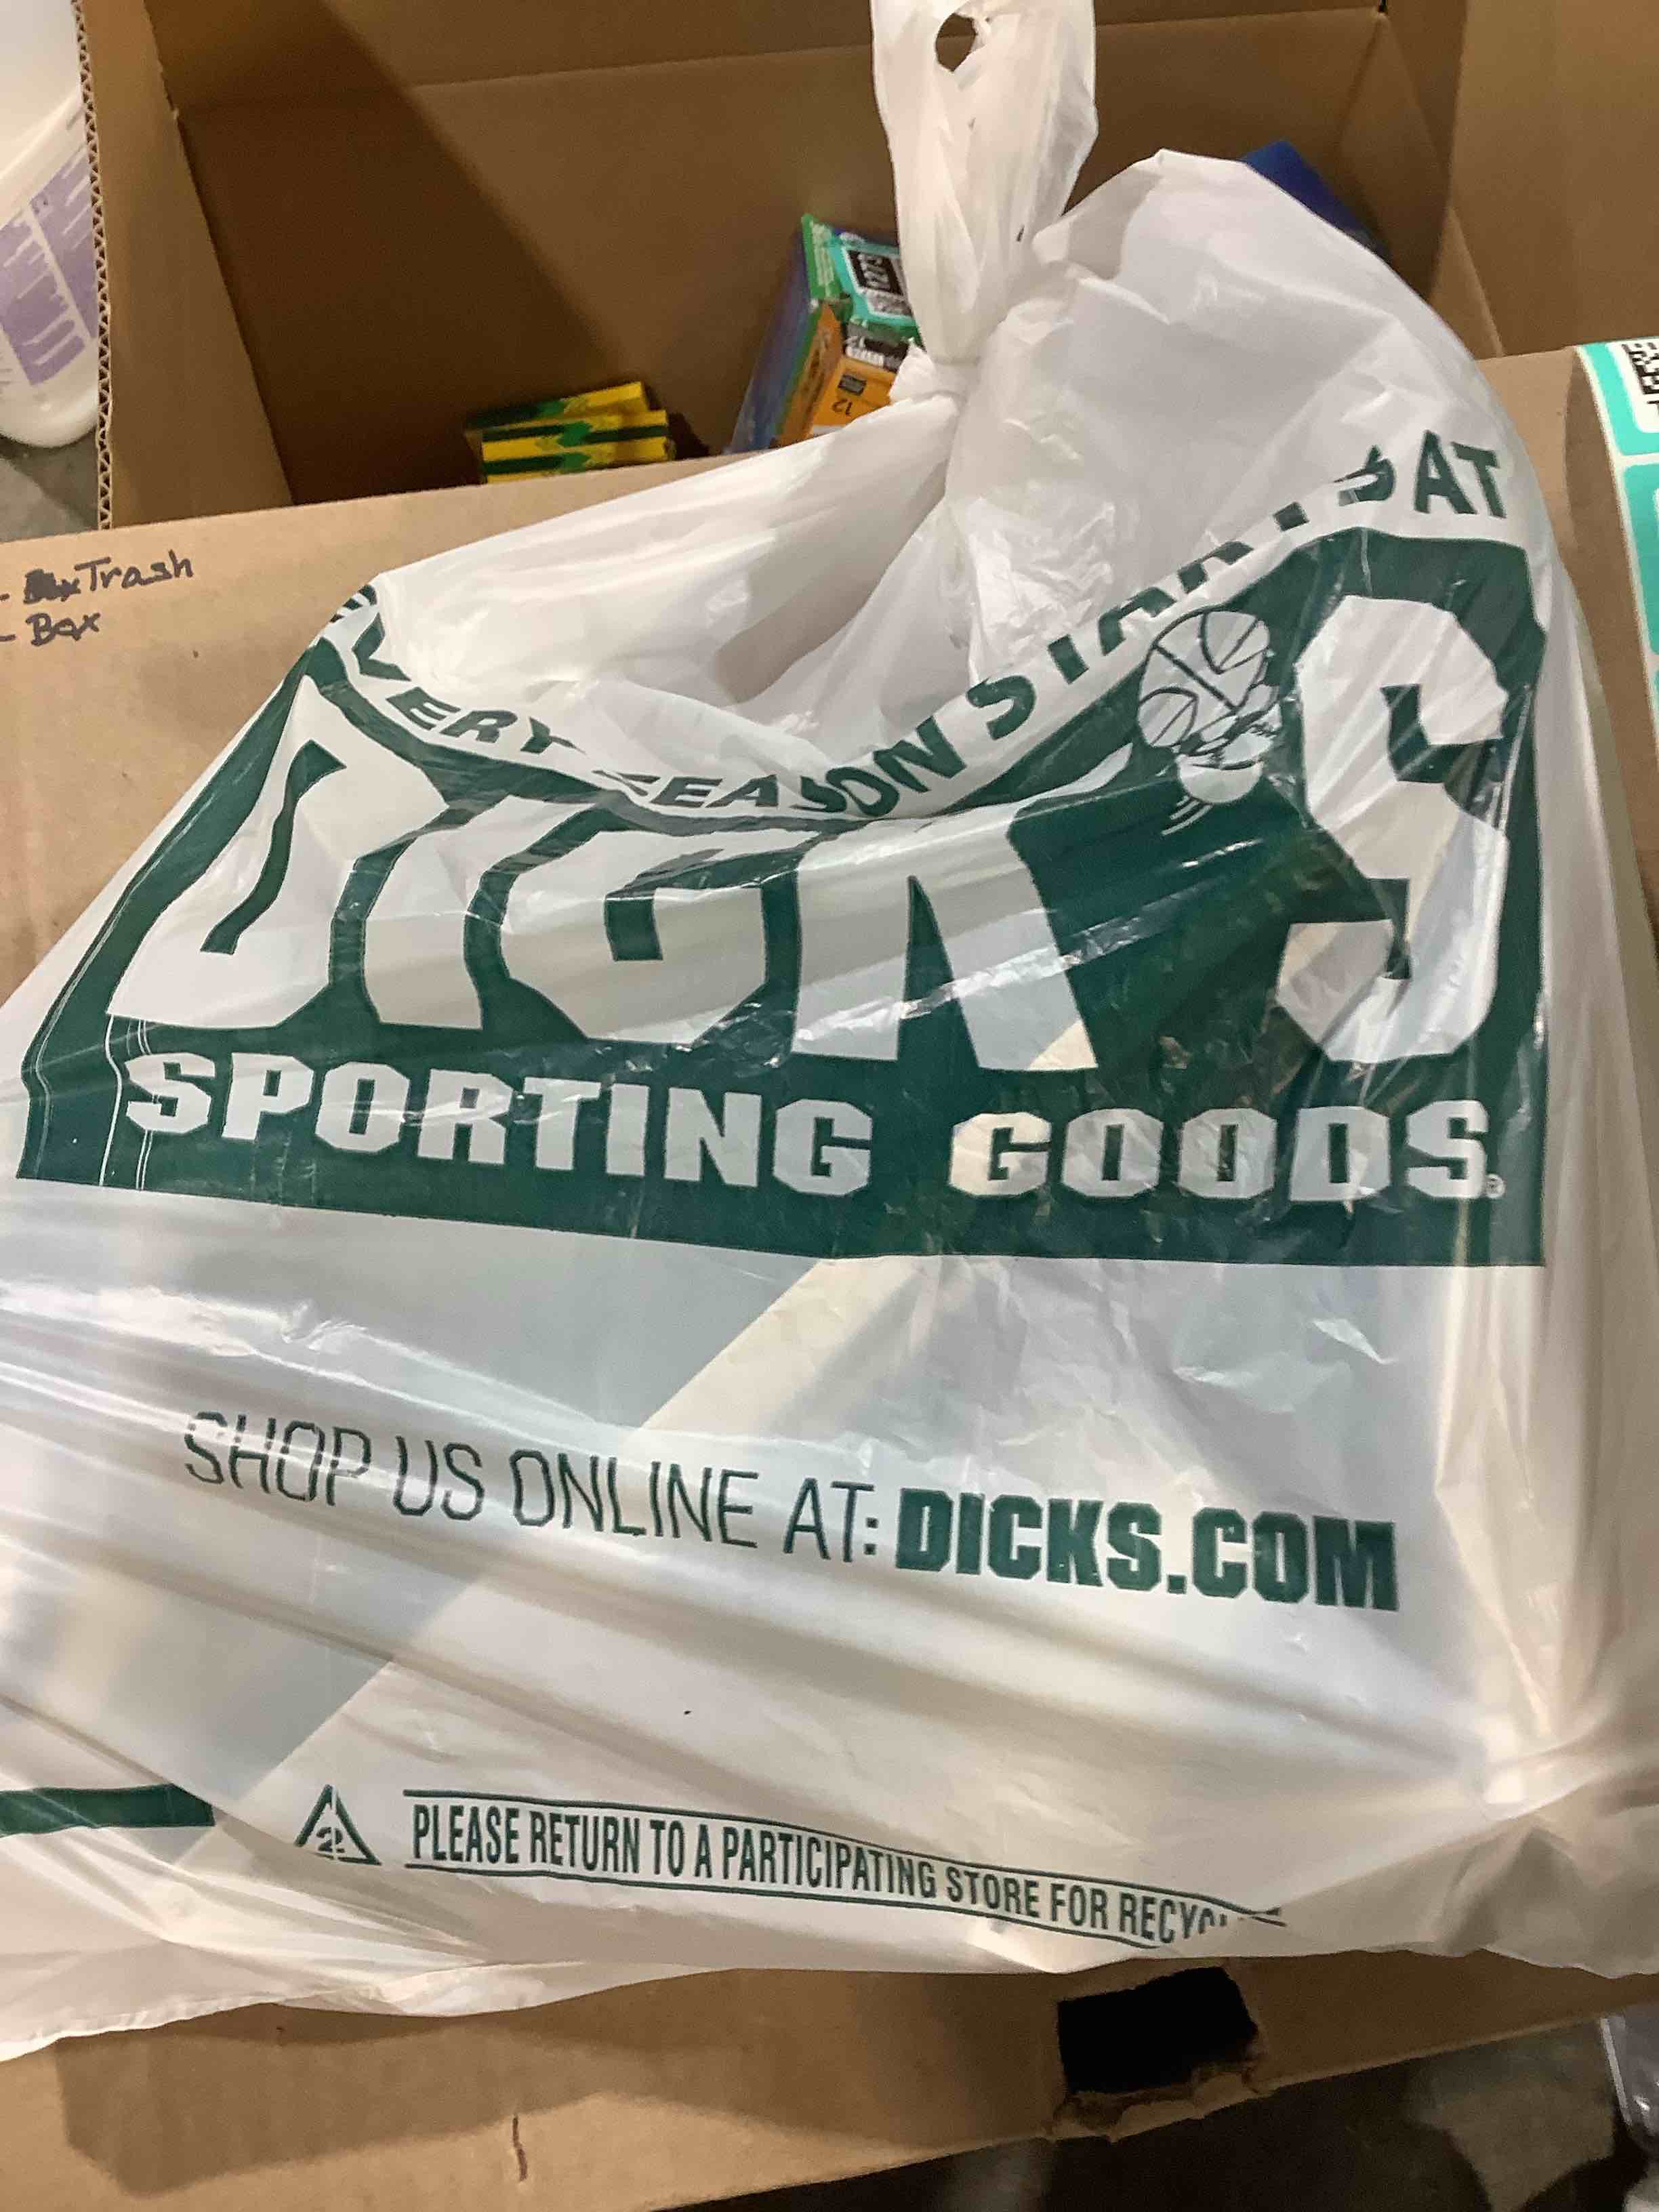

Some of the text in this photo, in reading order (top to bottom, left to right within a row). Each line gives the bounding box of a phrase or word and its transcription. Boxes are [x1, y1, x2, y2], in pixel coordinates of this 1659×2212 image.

[1414, 430, 1507, 519] AT
[75, 549, 194, 592] Trash
[125, 1052, 1488, 1202] SPORTING GOODS
[184, 1410, 371, 1507] SHOP
[392, 1435, 485, 1521] US
[513, 1448, 760, 1549] ONLINE
[895, 1487, 1399, 1612] DICKS.COM
[412, 1803, 520, 1865] PLEASE
[529, 1809, 640, 1875] RETURN
[649, 1819, 684, 1878] TO
[694, 1824, 713, 1879] A
[722, 1826, 937, 1900] PARTICIPATING
[946, 1865, 1040, 1918] STORE
[1050, 1882, 1107, 1930] FOR
